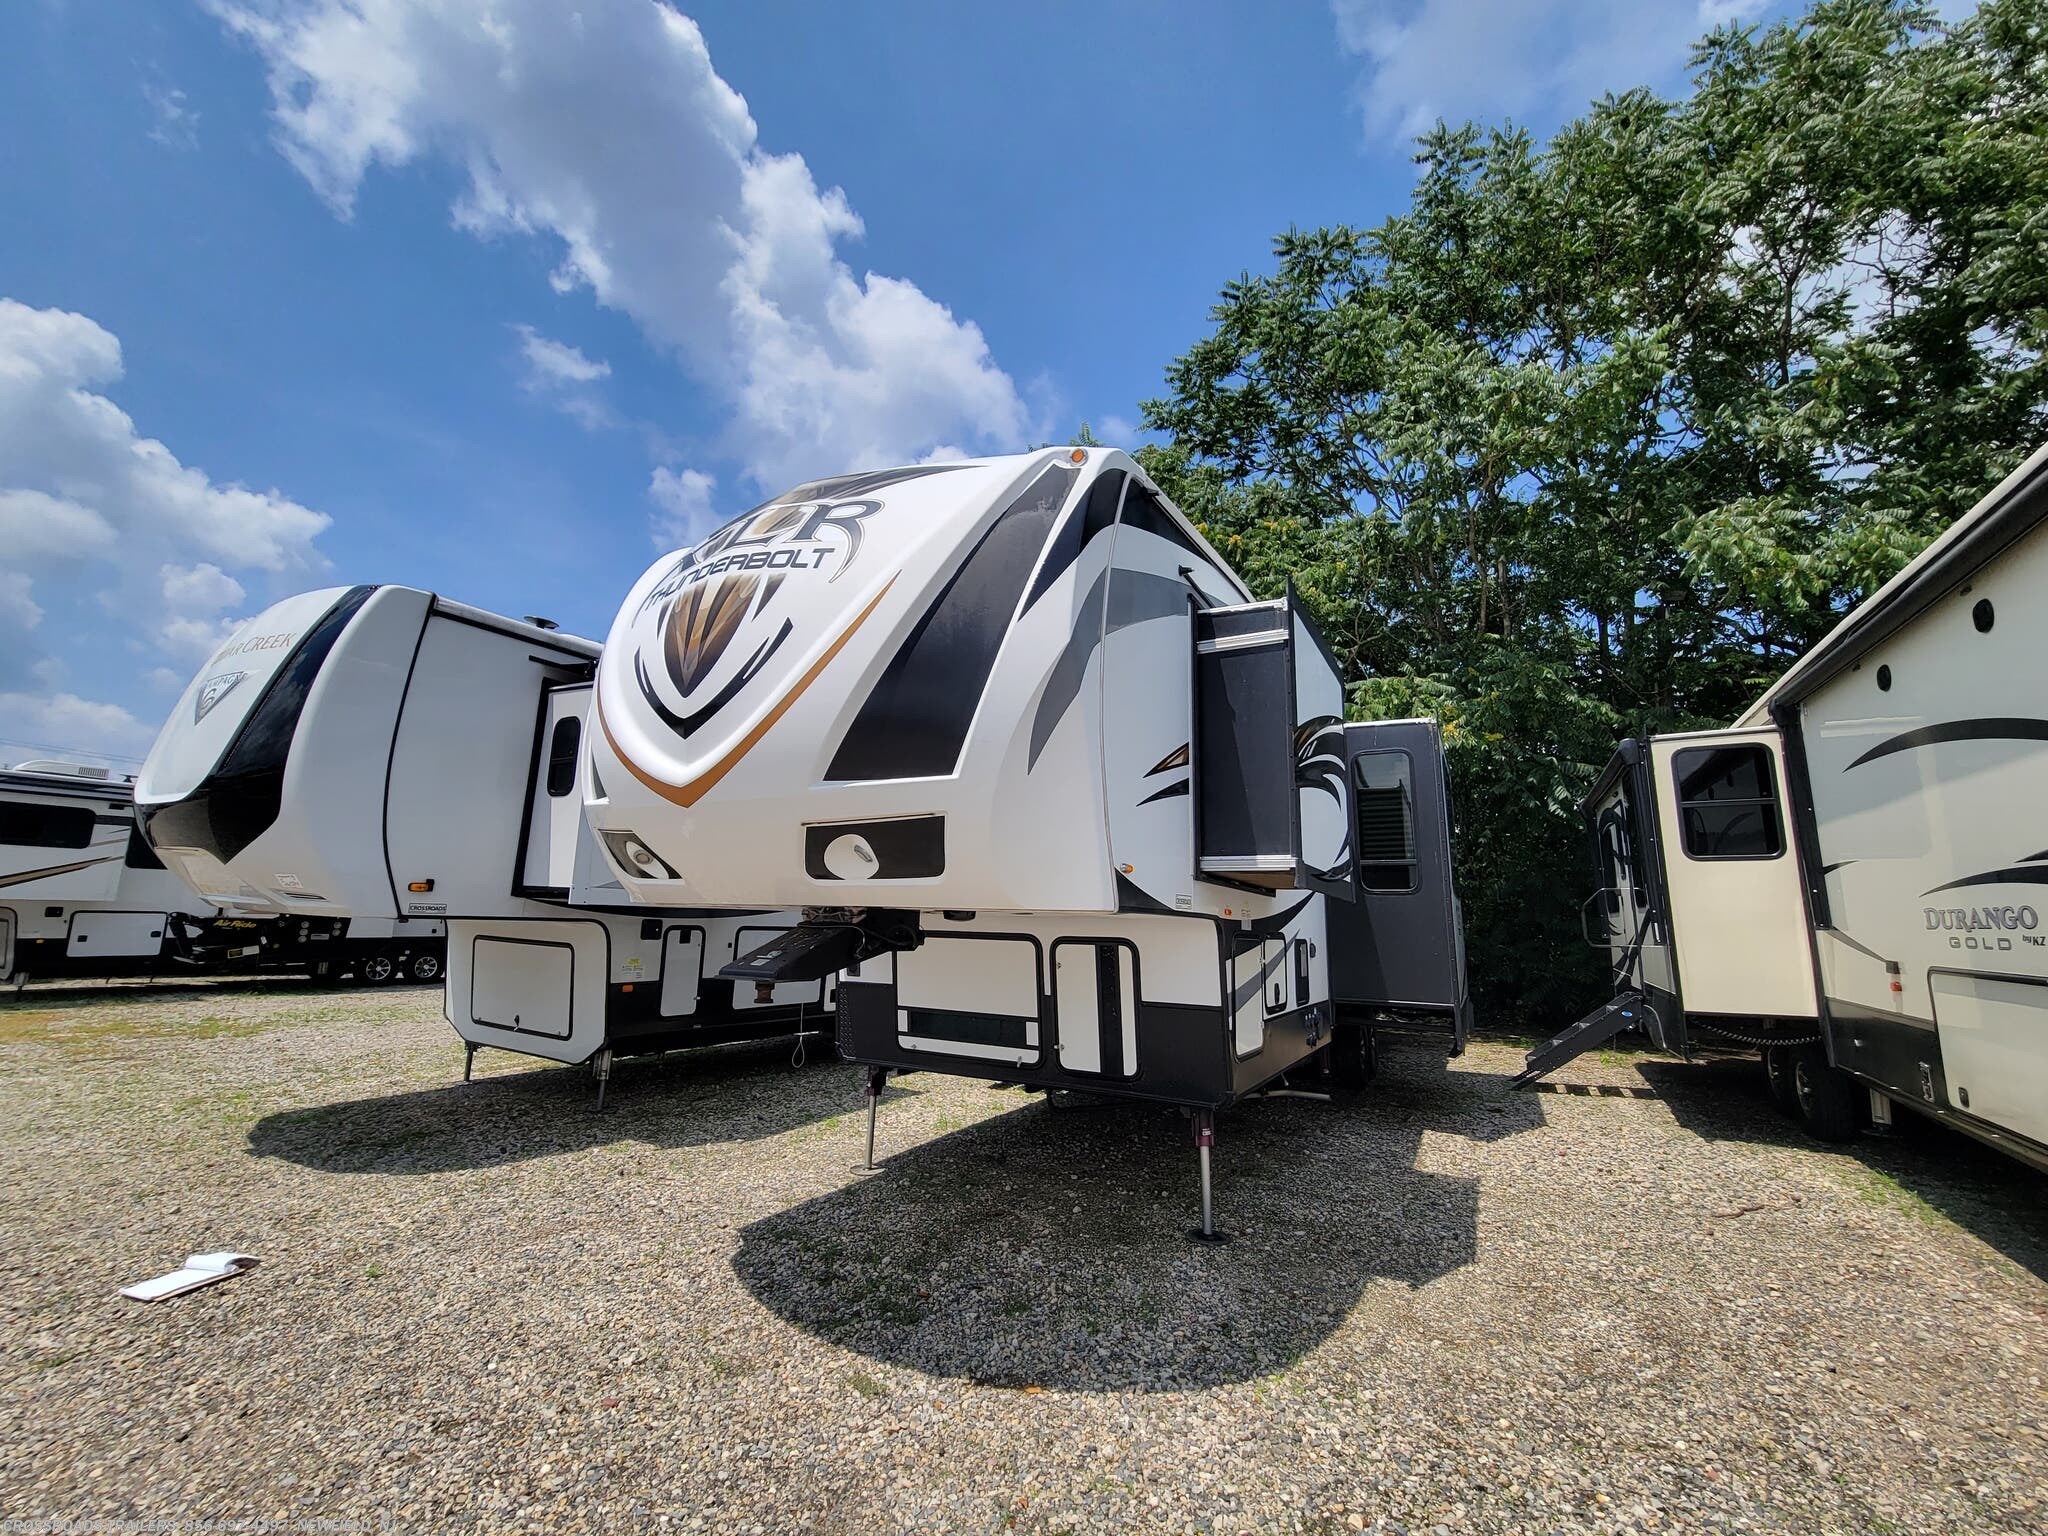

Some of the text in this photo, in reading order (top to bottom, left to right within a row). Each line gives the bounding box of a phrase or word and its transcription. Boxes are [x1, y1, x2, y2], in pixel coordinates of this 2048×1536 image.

[646, 547, 835, 611] THUNDERBOLT
[242, 633, 297, 653] CREEK
[212, 919, 257, 929] Air Ride
[1924, 905, 2039, 931] DURANGO
[1949, 936, 2012, 951] GOLD
[2032, 936, 2046, 946] KZ
